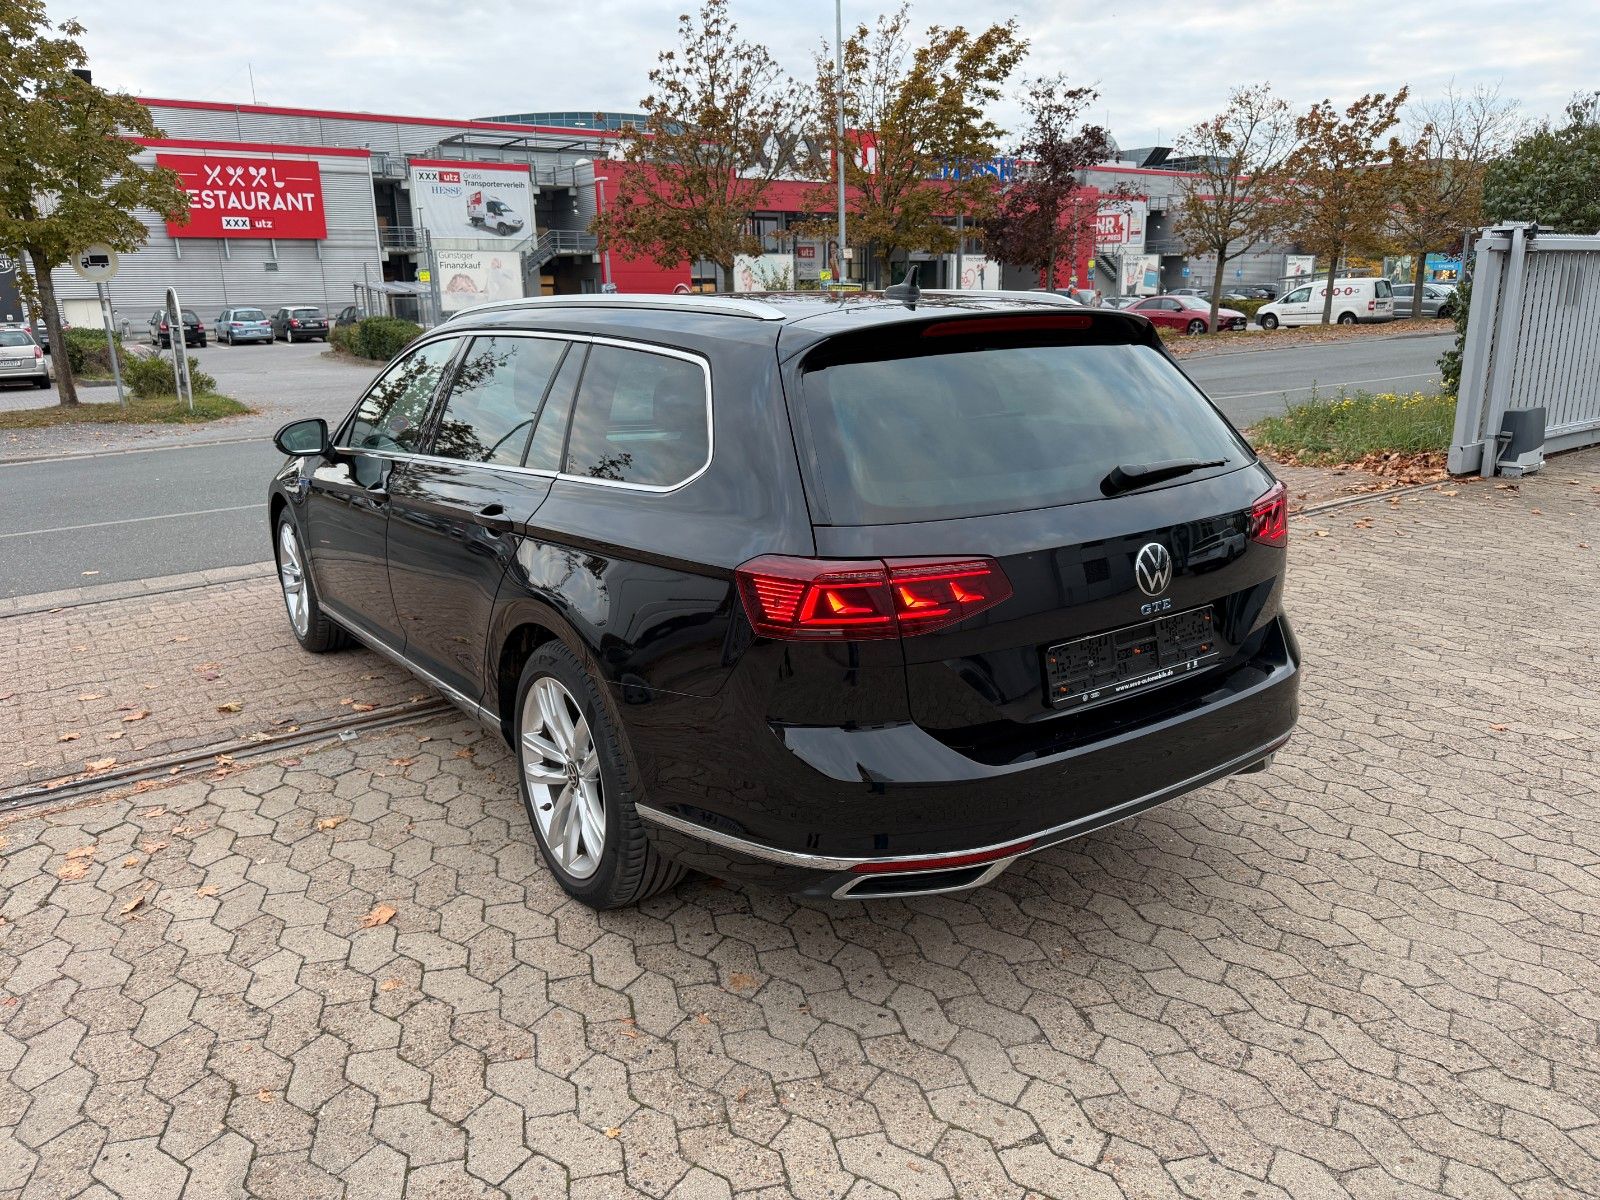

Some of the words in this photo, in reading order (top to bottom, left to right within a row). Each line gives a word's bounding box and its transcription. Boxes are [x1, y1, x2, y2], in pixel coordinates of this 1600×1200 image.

[464, 179, 525, 189] Transporterverleih
[187, 189, 315, 212] ESTAURANT
[1141, 598, 1171, 615] GTE
